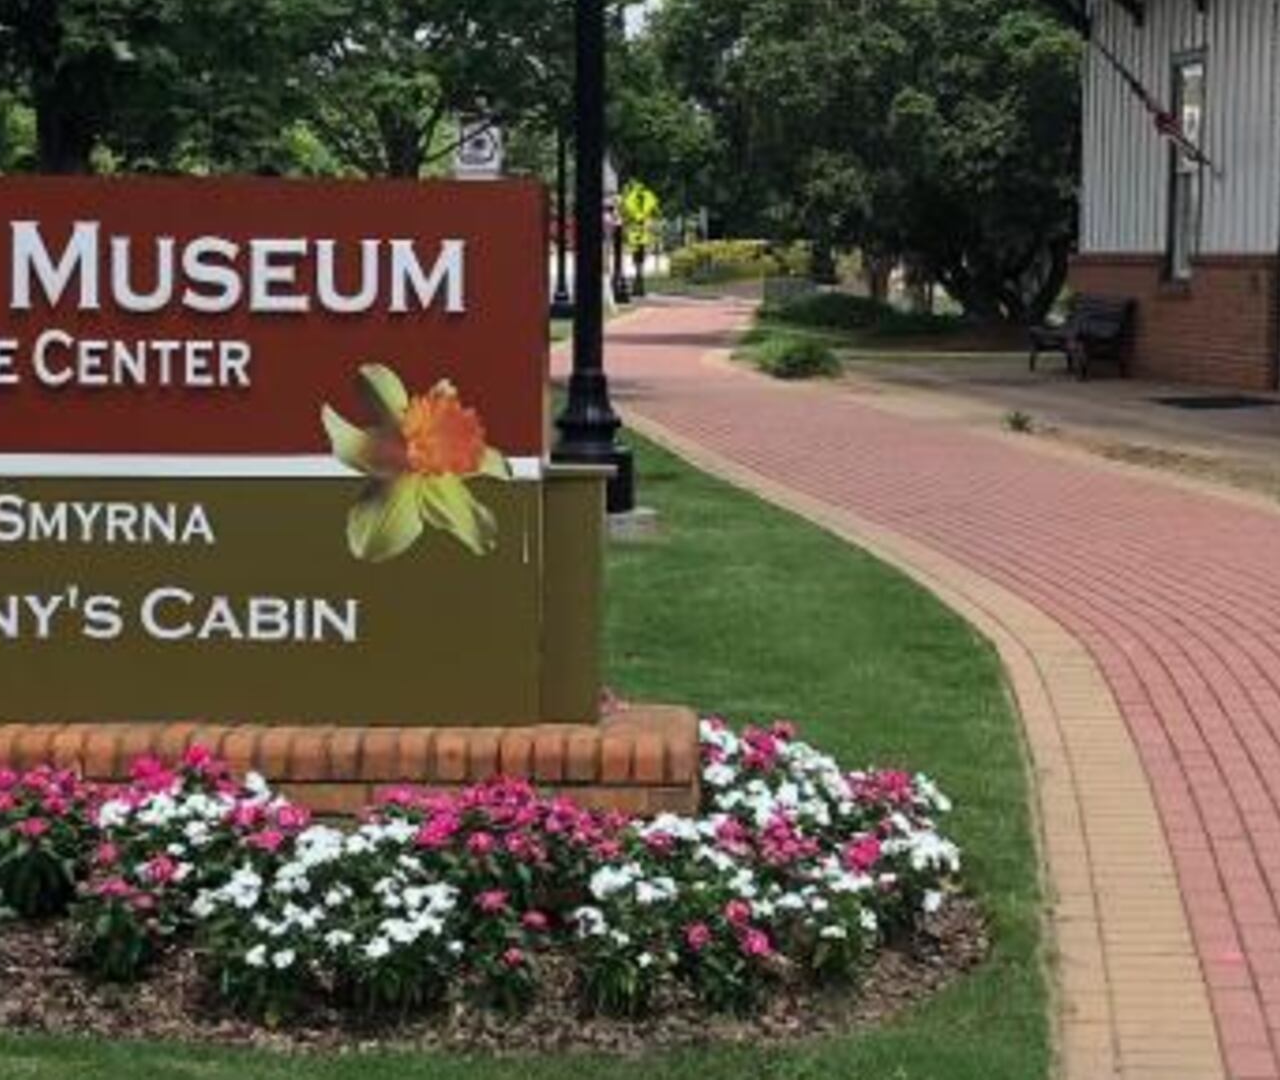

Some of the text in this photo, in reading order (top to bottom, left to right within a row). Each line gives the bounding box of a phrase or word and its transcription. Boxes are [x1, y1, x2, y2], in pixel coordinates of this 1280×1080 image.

[10, 220, 465, 312] MUSEUM
[32, 329, 251, 386] CENTER
[140, 587, 357, 641] CABIN
